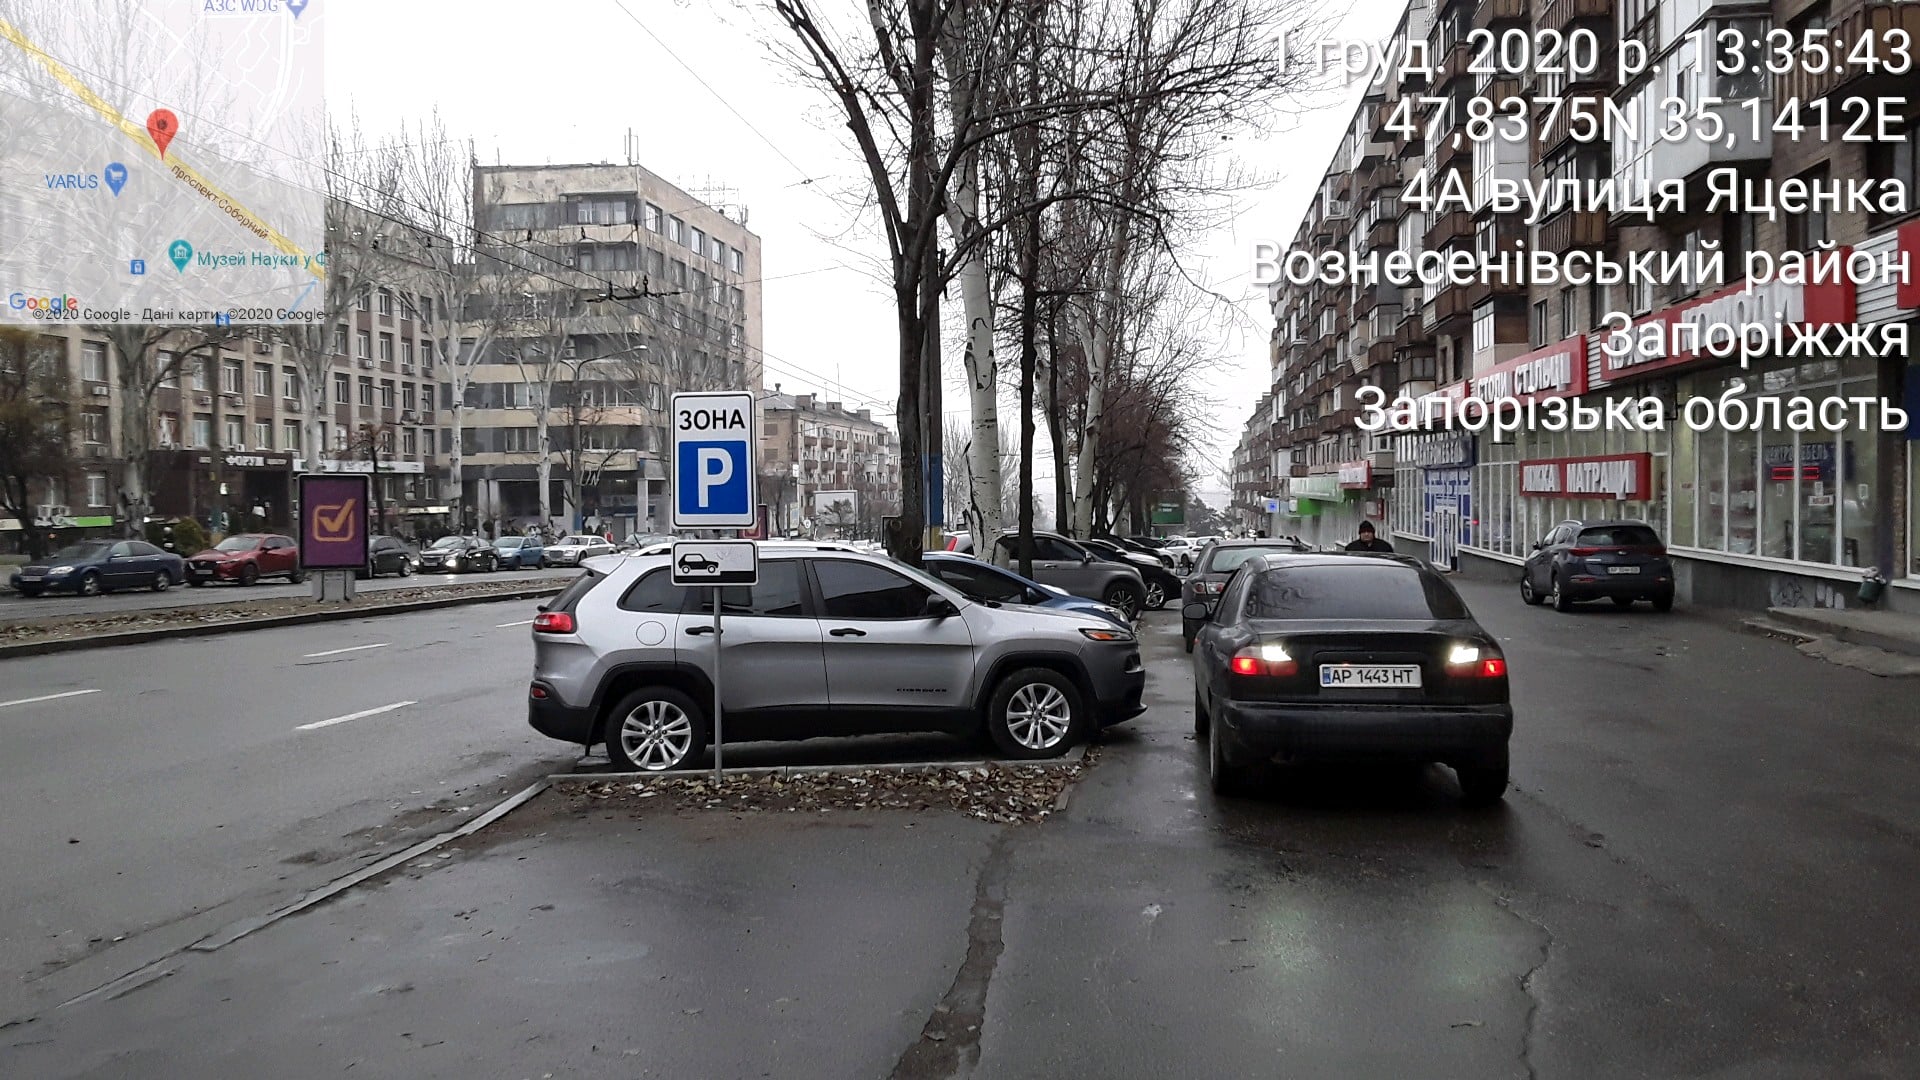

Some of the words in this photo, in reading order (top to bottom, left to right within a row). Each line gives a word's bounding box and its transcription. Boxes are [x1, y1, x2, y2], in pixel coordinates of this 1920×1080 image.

[679, 409, 746, 430] ЗОНА
[1566, 460, 1637, 500] МАТРАЦИ
[1331, 669, 1352, 684] AP
[1356, 669, 1389, 684] 1443
[1392, 669, 1414, 684] HT
